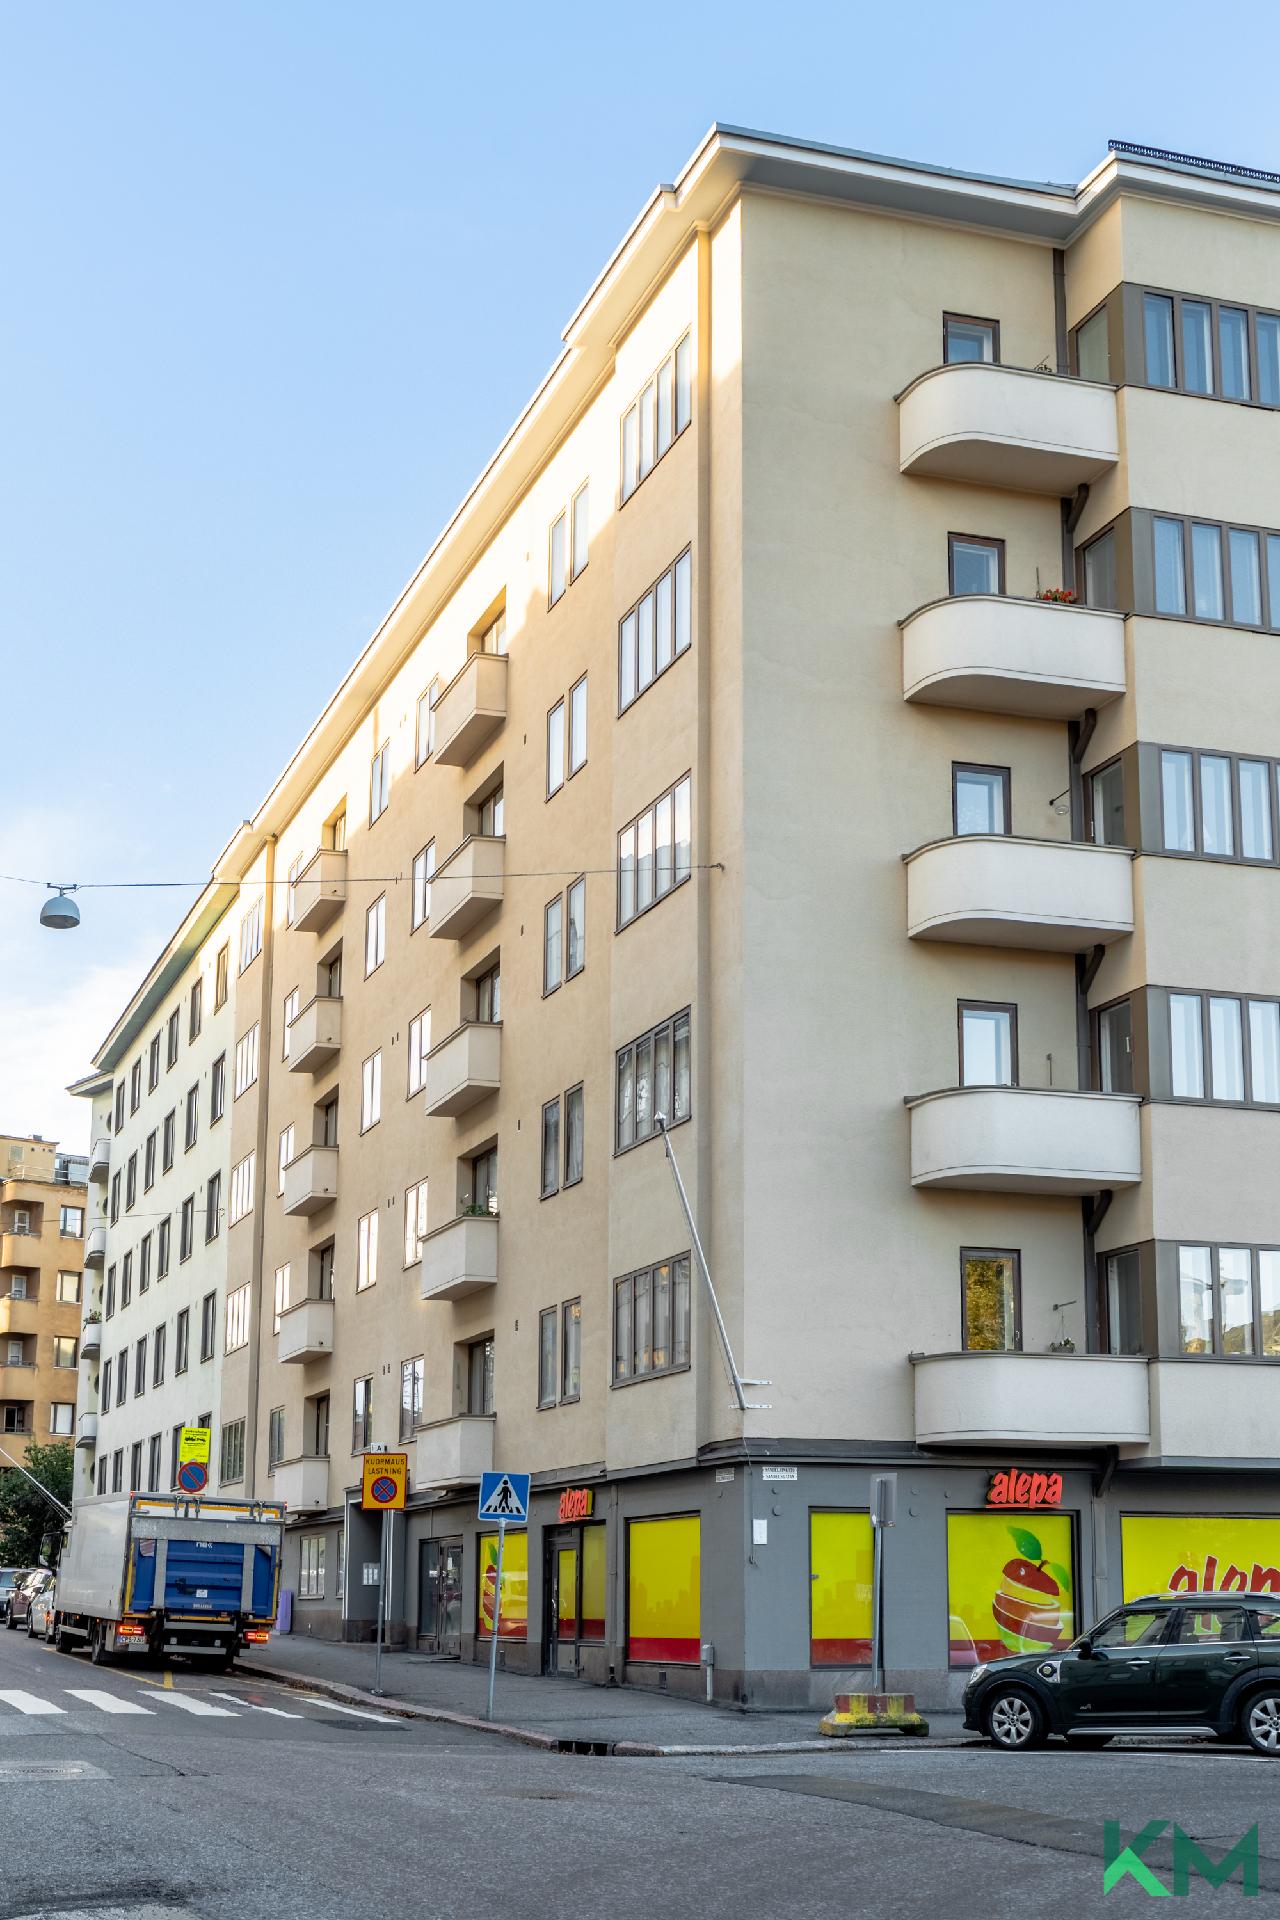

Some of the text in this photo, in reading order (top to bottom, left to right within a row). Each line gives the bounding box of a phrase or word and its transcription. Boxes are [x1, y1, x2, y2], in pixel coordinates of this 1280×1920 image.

[368, 1467, 402, 1475] LASTNING
[559, 1487, 588, 1519] alepa
[989, 1467, 1063, 1508] alepa
